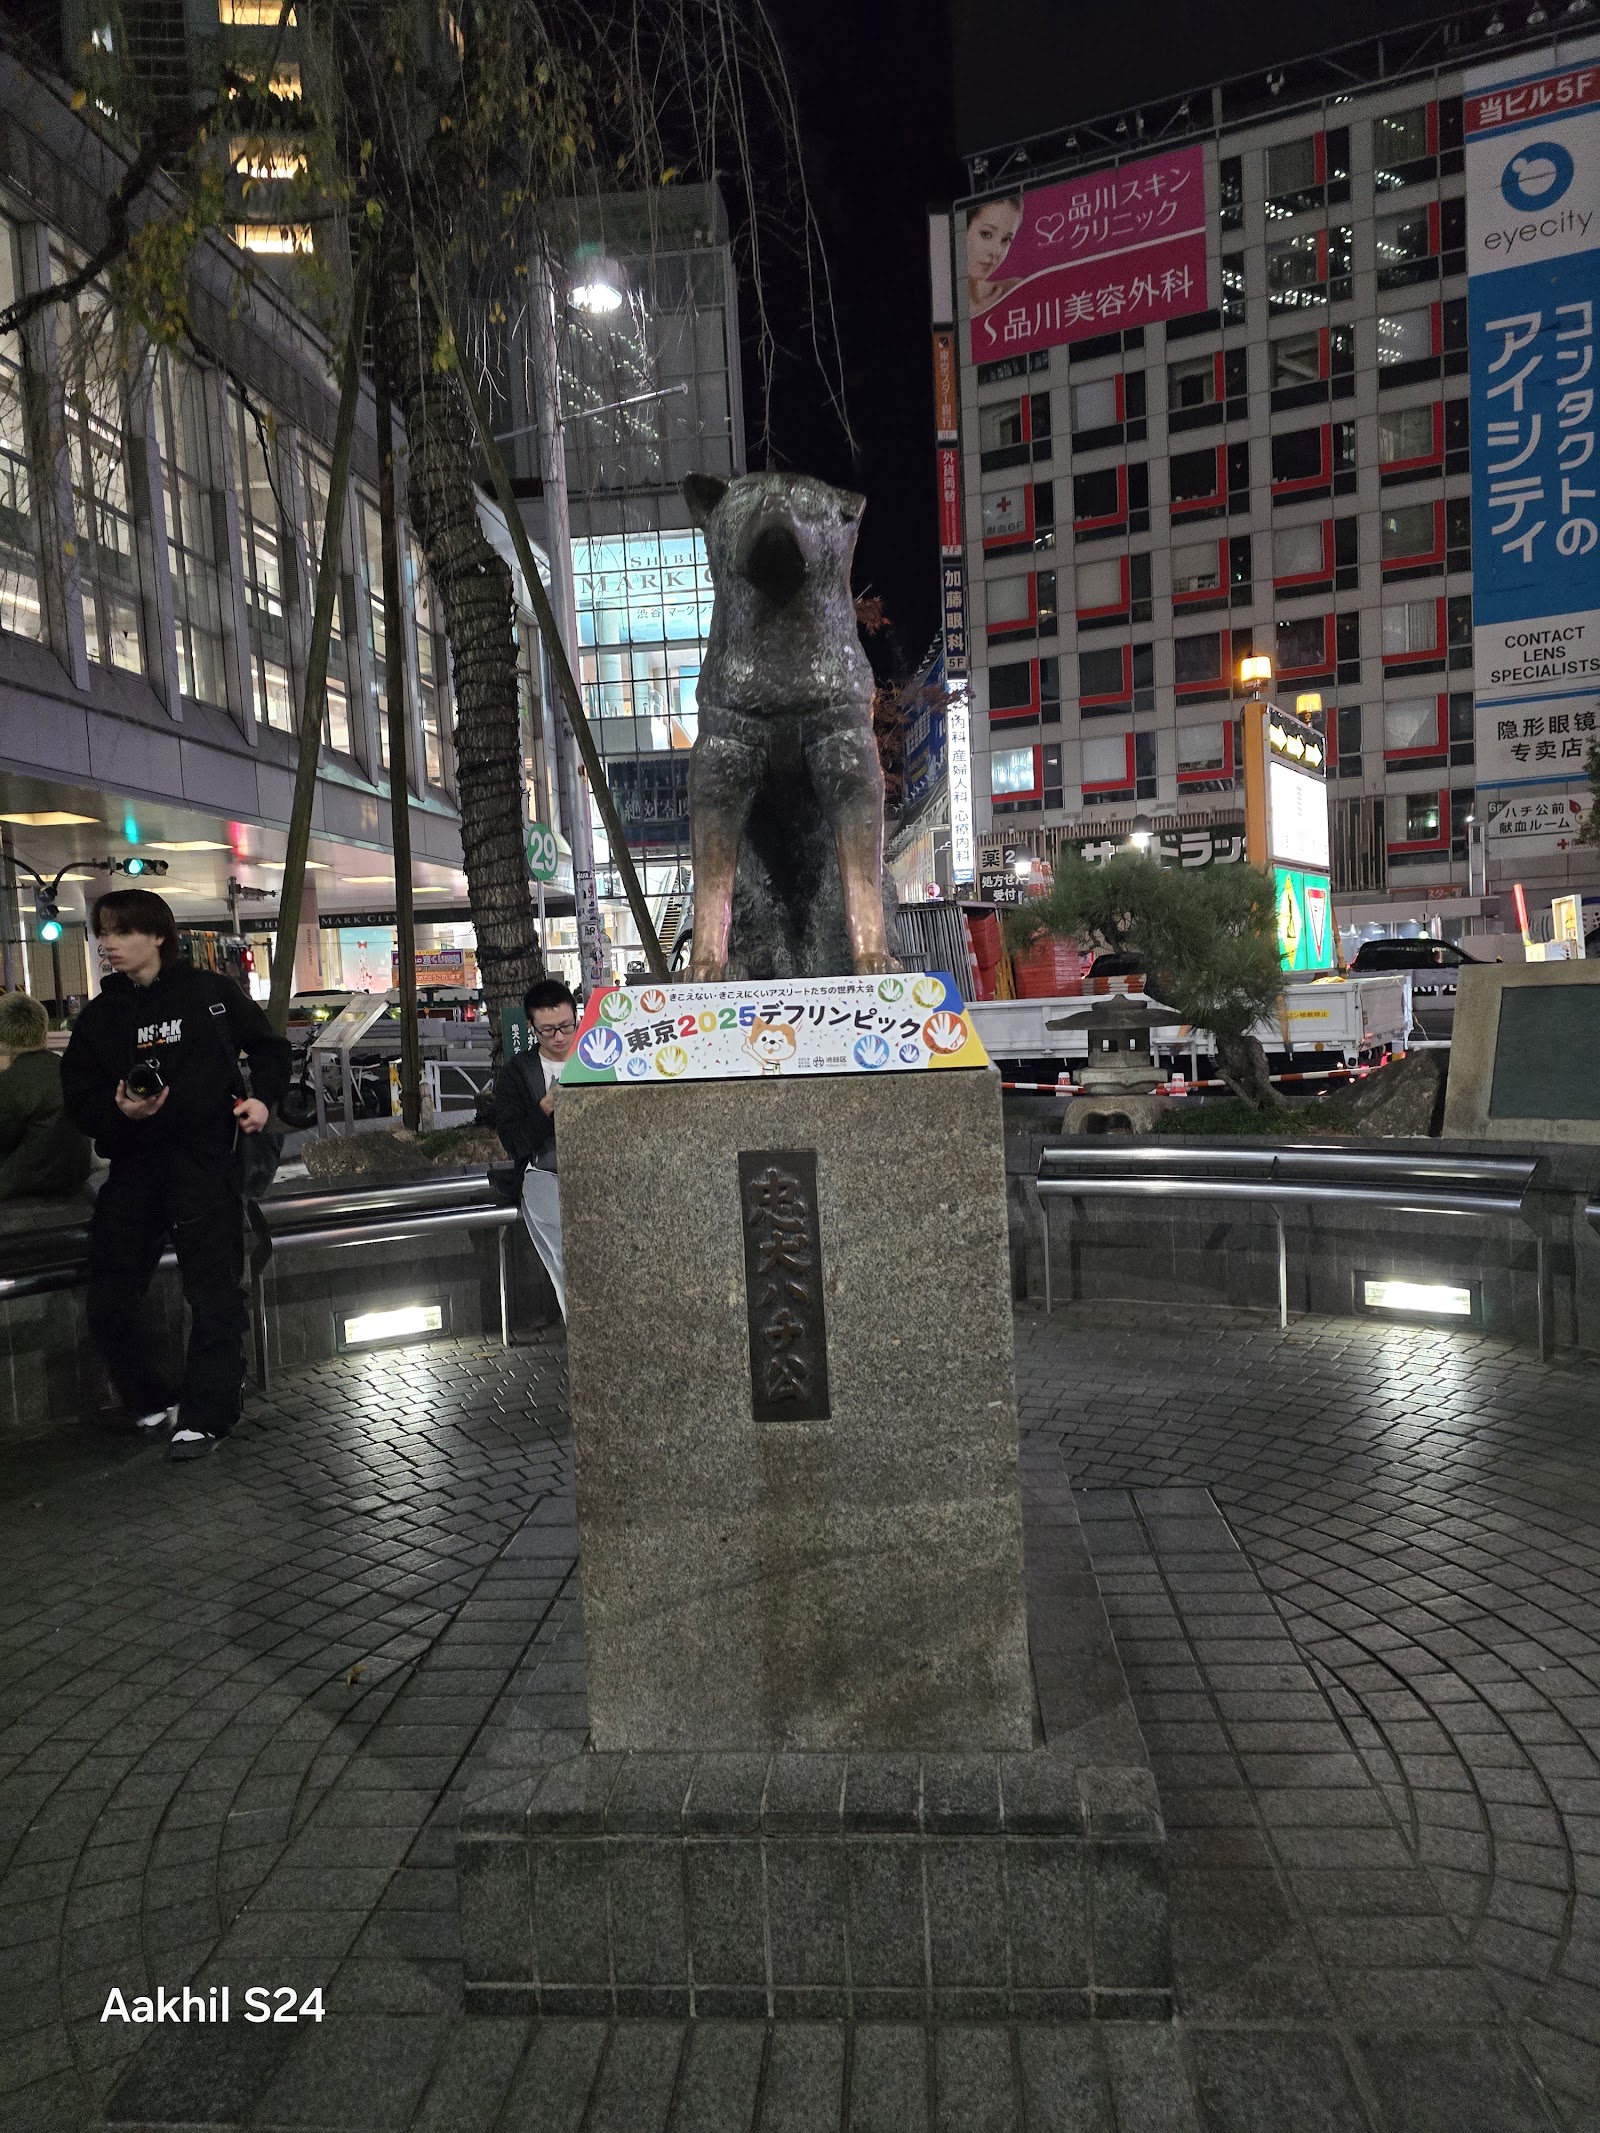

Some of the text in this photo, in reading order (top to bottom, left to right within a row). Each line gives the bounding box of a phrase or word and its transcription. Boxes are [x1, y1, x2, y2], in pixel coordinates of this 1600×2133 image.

[1479, 73, 1593, 126] 当ビル5F
[1068, 168, 1191, 222] 品川スキン
[1070, 201, 1178, 250] クリニック
[1484, 210, 1593, 254] eyecity
[1004, 264, 1194, 342] 品川美容外科
[1485, 310, 1547, 563] アイシティ
[1555, 300, 1599, 556] コンタクトの
[943, 451, 956, 503] 外貨両替
[630, 553, 708, 568] SHIBU
[579, 571, 685, 594] MARK
[945, 569, 964, 650] 加藤眼科
[1504, 626, 1585, 649] CONTACT
[1523, 646, 1566, 663] LENS
[949, 658, 964, 668] 5F
[1491, 658, 1600, 683] SPECIALISTS
[1498, 711, 1596, 741] 隐形眼镜
[1510, 737, 1582, 763] 专卖店
[952, 750, 968, 803] 産婦人科
[1499, 818, 1570, 834] 献血ルーム
[1505, 801, 1565, 818] ハチ公前
[530, 830, 554, 870] 29
[954, 810, 970, 862] 心療内科
[982, 849, 1000, 868] 薬
[321, 917, 361, 926] MARK
[624, 1002, 922, 1054] 東京2025デフリンピック
[749, 1166, 813, 1401] 忠犬ハチ公
